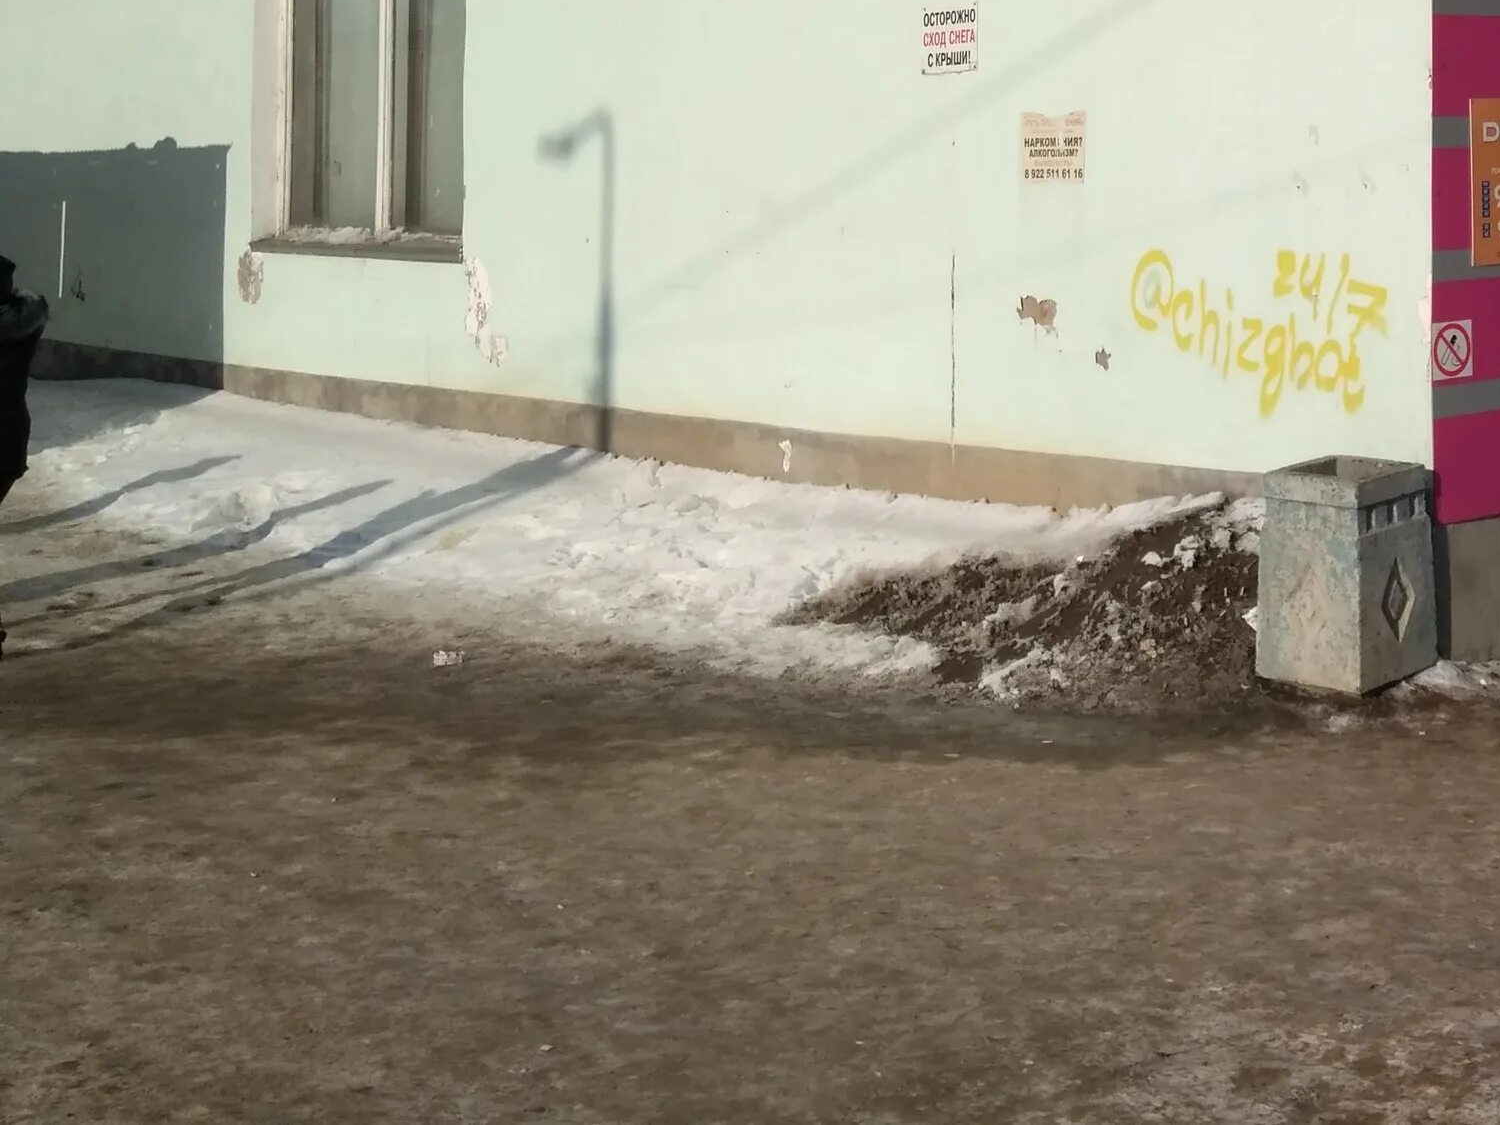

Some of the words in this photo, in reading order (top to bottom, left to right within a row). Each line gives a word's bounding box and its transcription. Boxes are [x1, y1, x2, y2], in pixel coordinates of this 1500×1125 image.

[923, 8, 976, 27] ОСТОРОЖНО
[923, 31, 946, 48] СХОД
[949, 29, 975, 44] СНЕГА
[928, 53, 934, 68] С
[936, 50, 971, 67] КРЫШИ!
[1025, 169, 1029, 179] 8
[1031, 168, 1044, 179] 922
[1047, 168, 1059, 179] 511
[1062, 168, 1071, 179] 61
[1074, 168, 1083, 179] 16
